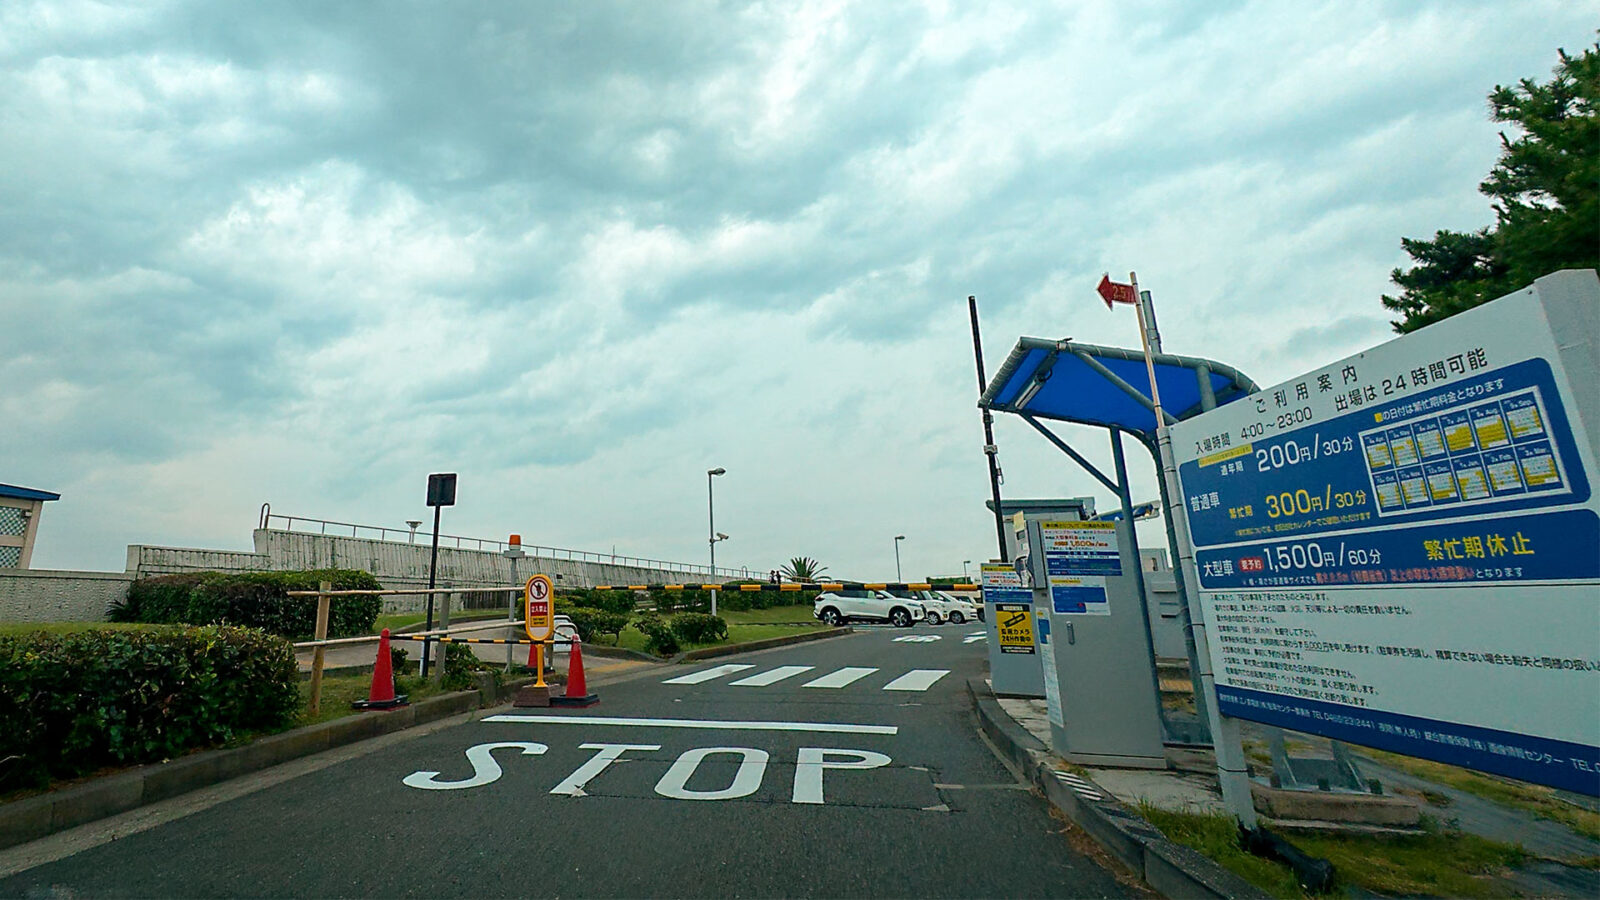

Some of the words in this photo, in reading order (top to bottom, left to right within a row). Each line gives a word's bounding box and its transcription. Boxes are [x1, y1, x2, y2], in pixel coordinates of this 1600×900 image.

[1255, 365, 1358, 414] ご利用案内
[1195, 432, 1231, 455] 入場時間
[1190, 491, 1221, 513] 普通車
[1423, 531, 1535, 561] 繁忙期休止
[1203, 559, 1235, 578] 大型車
[403, 742, 892, 804] STOP
